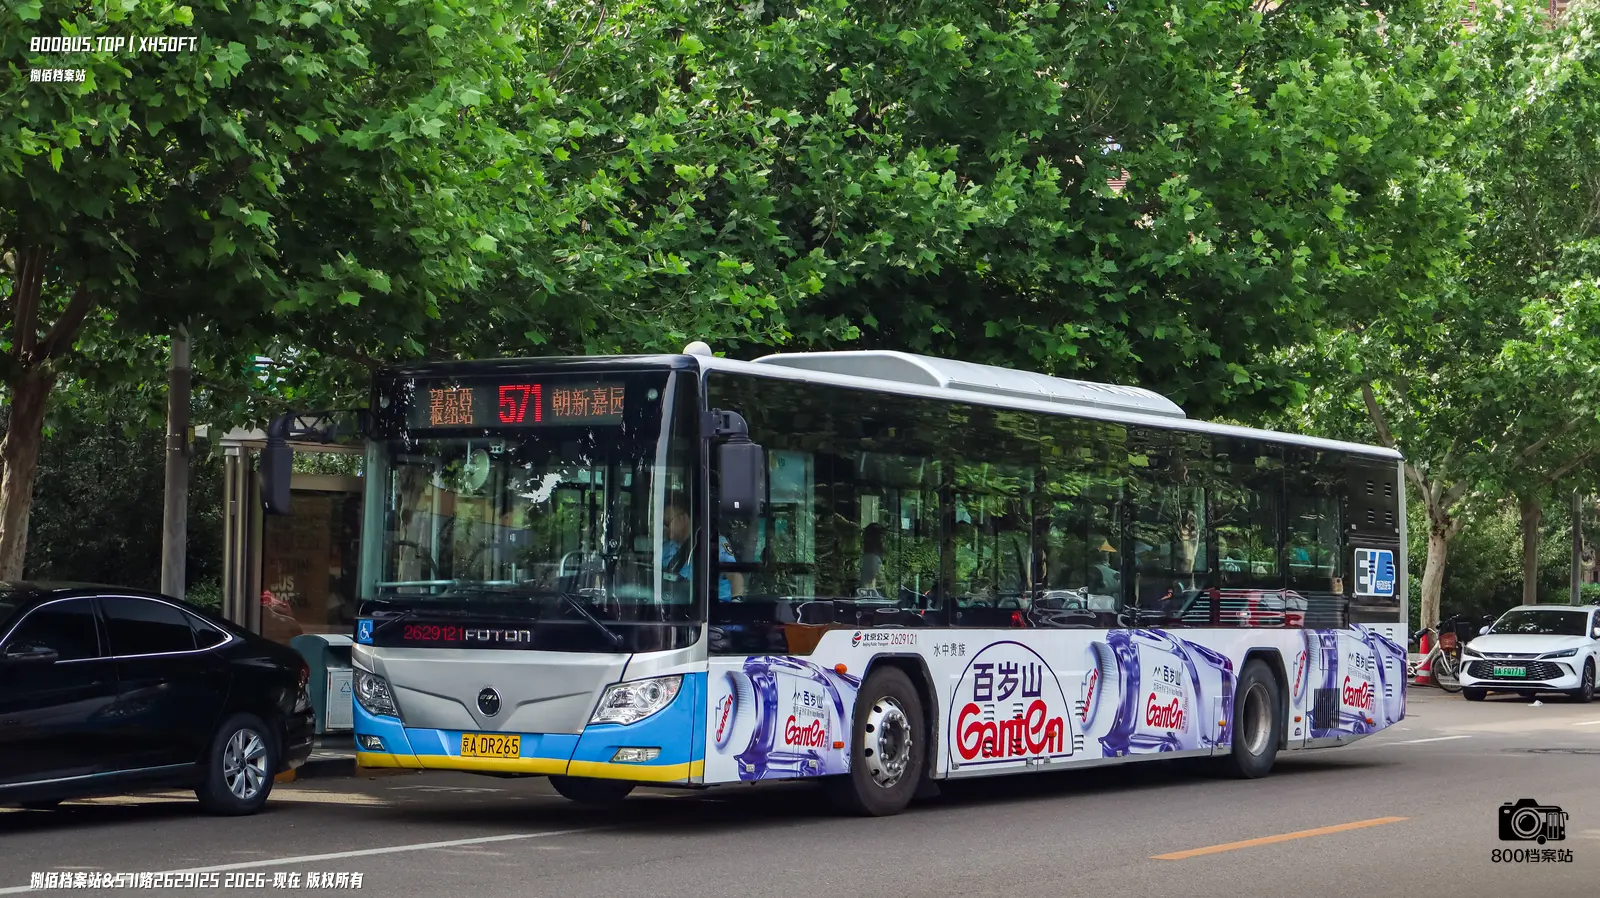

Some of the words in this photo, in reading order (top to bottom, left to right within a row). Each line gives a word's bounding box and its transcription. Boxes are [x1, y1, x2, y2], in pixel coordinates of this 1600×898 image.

[498, 384, 542, 424] 571
[551, 386, 625, 418] 朝新嘉园
[429, 405, 473, 425] 枢纽站
[403, 625, 464, 641] 2629121
[465, 629, 531, 643] FOTON
[863, 632, 890, 642] 北京公交
[890, 633, 918, 645] 2629121
[933, 643, 966, 658] 水中贵族
[973, 661, 1042, 702] 百岁山
[1163, 664, 1181, 687] 百岁山
[803, 690, 824, 709] 百岁山
